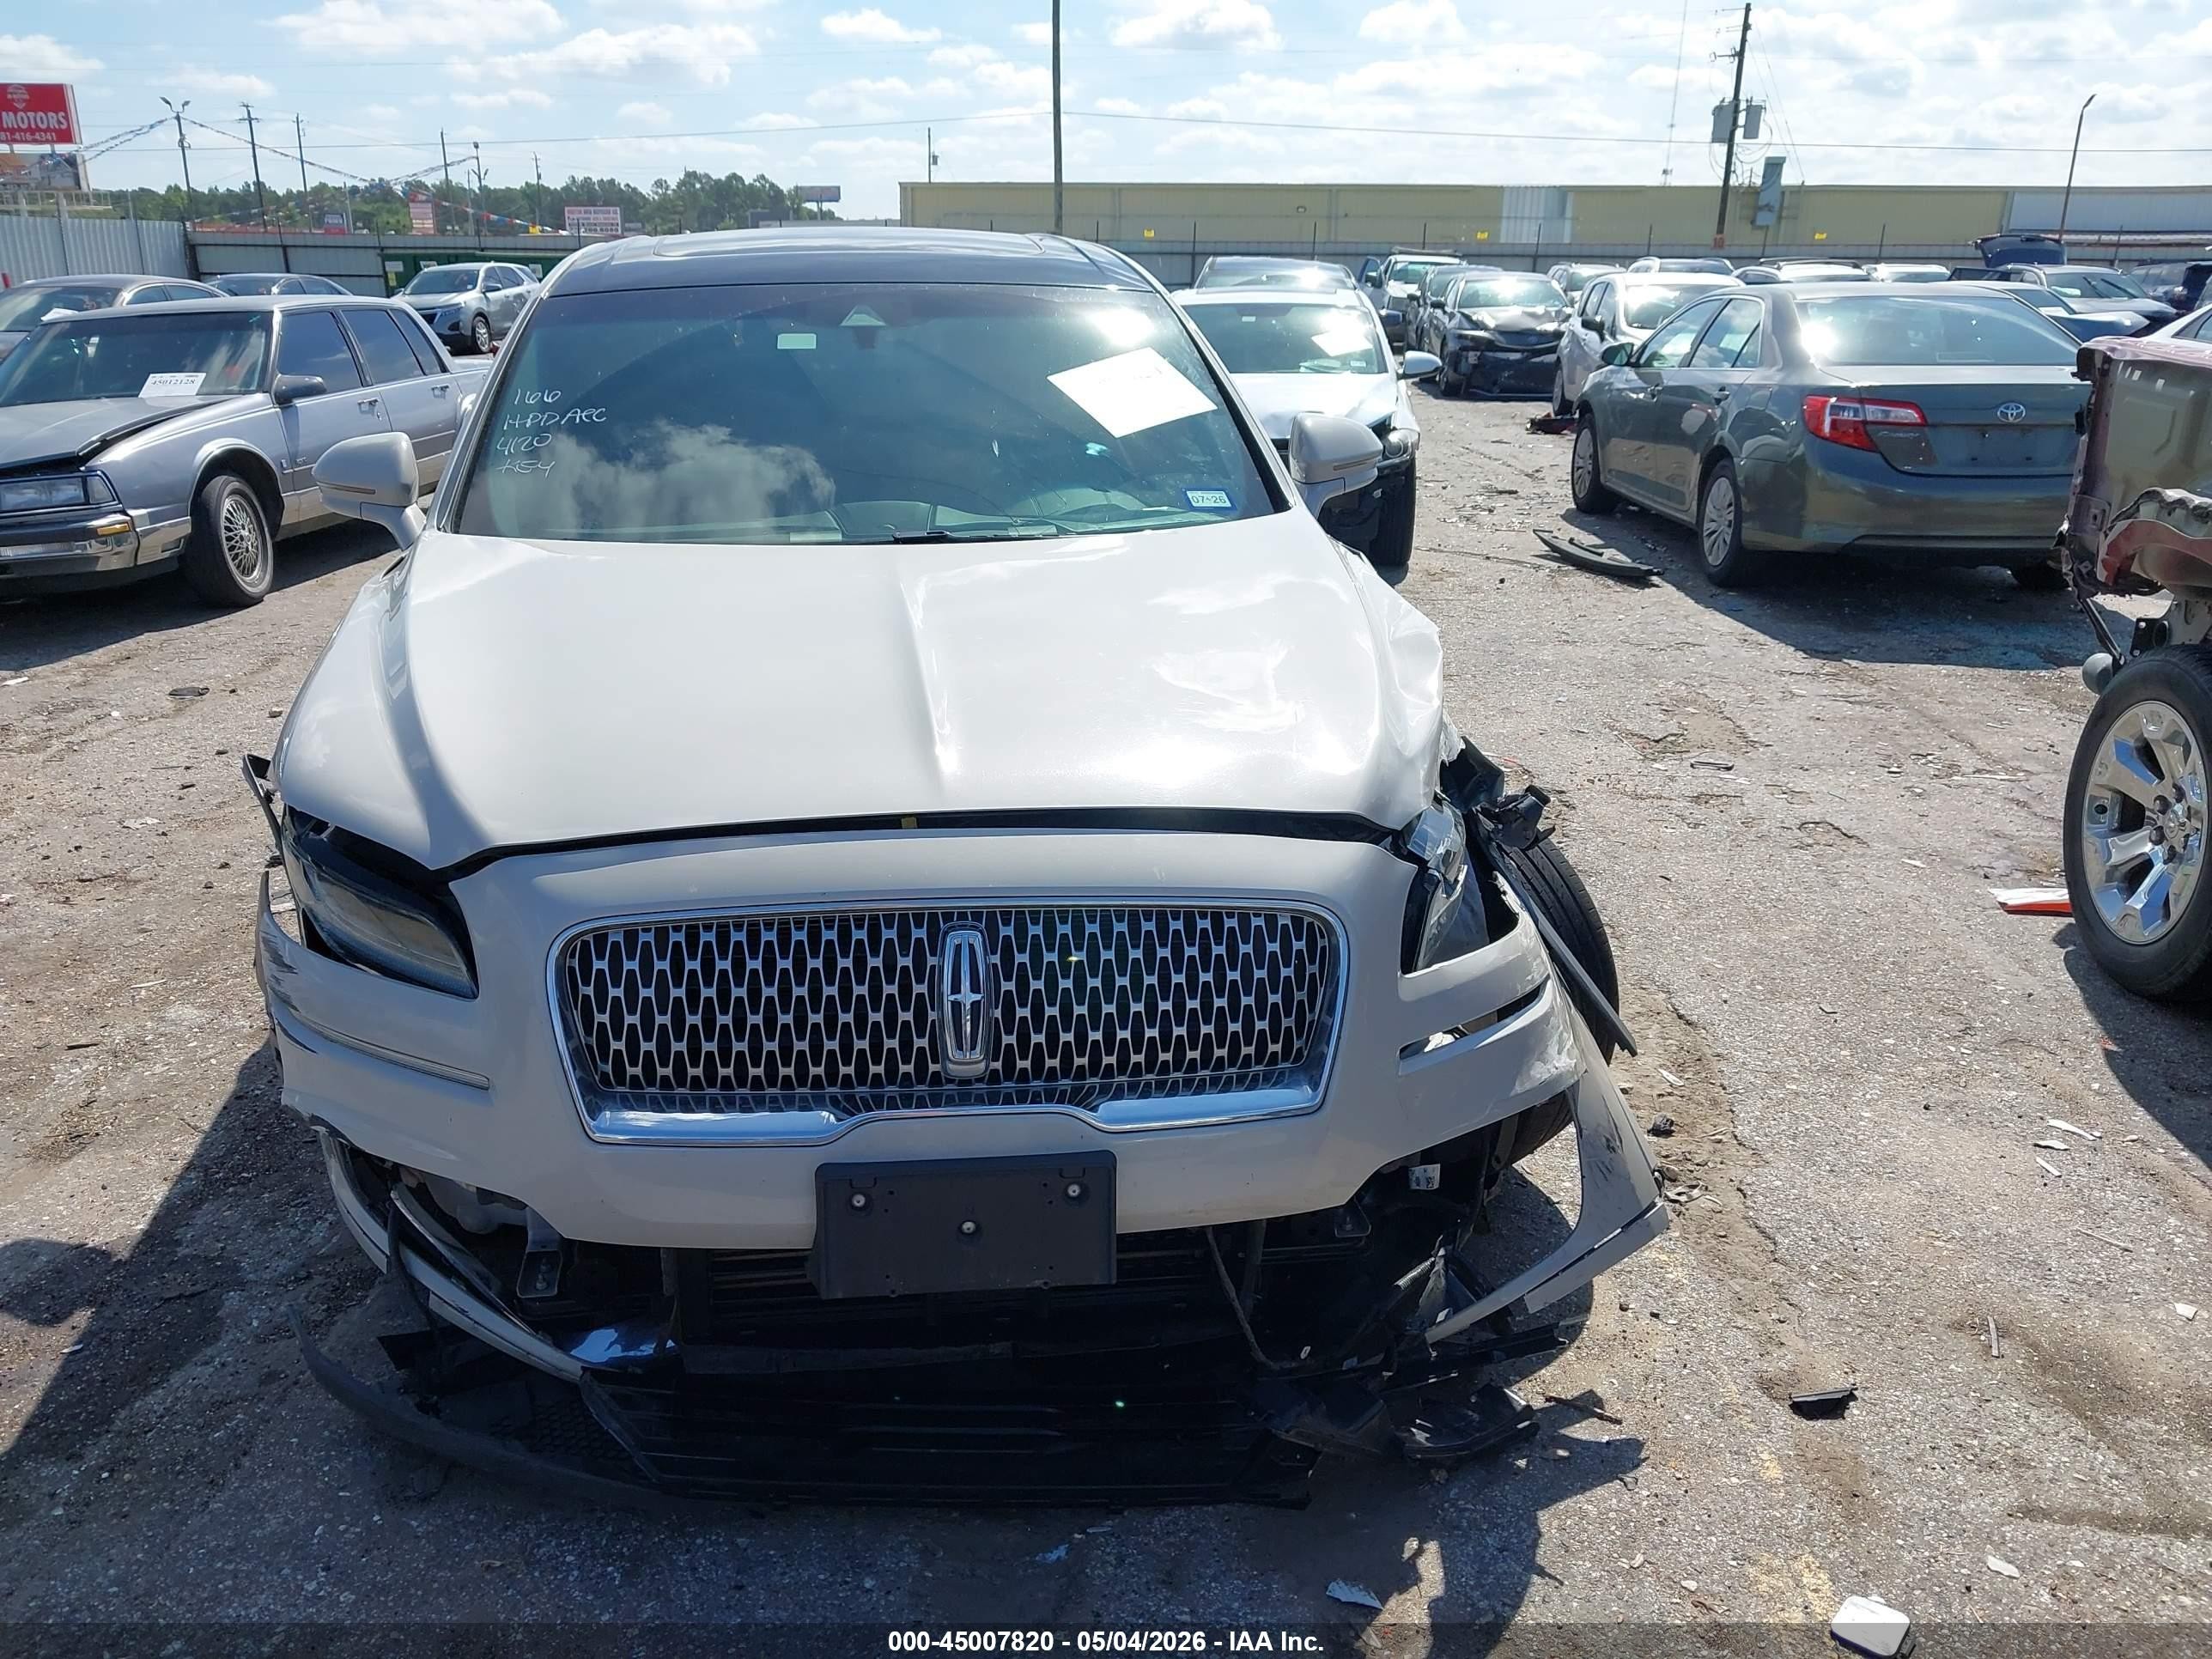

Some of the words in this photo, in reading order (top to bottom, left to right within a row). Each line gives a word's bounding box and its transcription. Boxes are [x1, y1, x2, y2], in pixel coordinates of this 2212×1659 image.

[1, 111, 69, 130] MOTORS
[514, 388, 562, 405] 166
[496, 433, 552, 455] 4120
